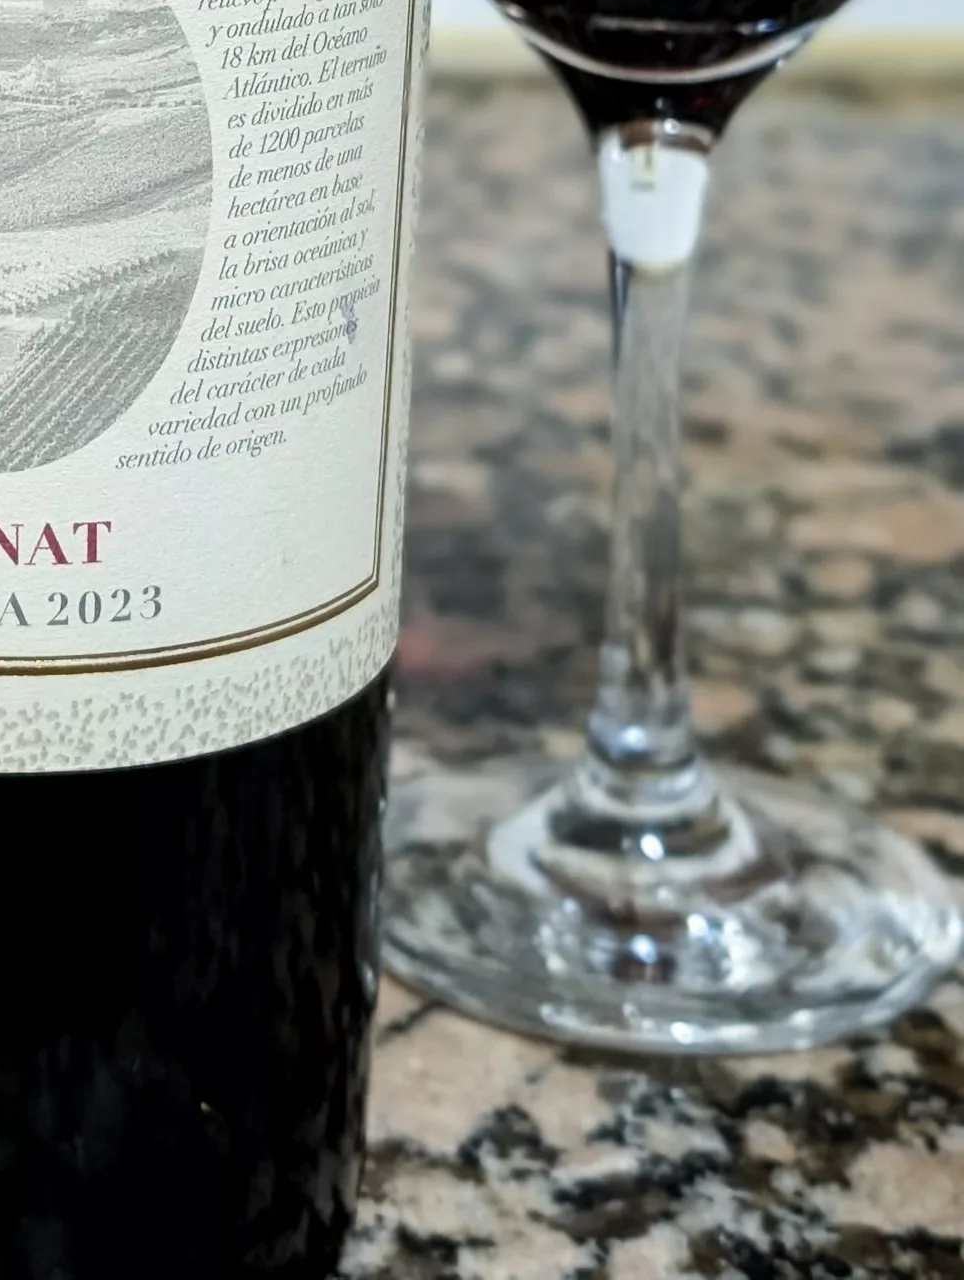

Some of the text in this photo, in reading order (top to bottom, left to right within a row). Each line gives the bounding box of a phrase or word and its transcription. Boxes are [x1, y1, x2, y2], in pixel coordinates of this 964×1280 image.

[206, 24, 220, 47] y
[226, 4, 314, 39] ondulado
[319, 7, 329, 23] a
[333, 3, 356, 20] tan
[222, 22, 367, 69] 18 km del Océano
[223, 68, 312, 100] Atlántico.
[318, 56, 338, 84] El
[228, 79, 373, 129] es dividido en más
[229, 111, 364, 159] de 1200 parcelas
[229, 145, 363, 189] de menos de una
[227, 173, 363, 220] hectárea en base
[224, 233, 236, 249] a
[243, 207, 337, 247] orientación
[340, 195, 356, 222] al
[219, 227, 368, 281] la brisa oceánica y
[201, 315, 233, 342] del
[235, 307, 285, 336] suelo.
[292, 300, 326, 324] Esto
[211, 286, 265, 312] micro
[170, 346, 346, 406] del carácter de cada
[187, 346, 268, 374] distintas
[149, 364, 367, 436] variedad con un profundo
[115, 429, 288, 470] sentido de origen.
[46, 584, 164, 626] 2023
